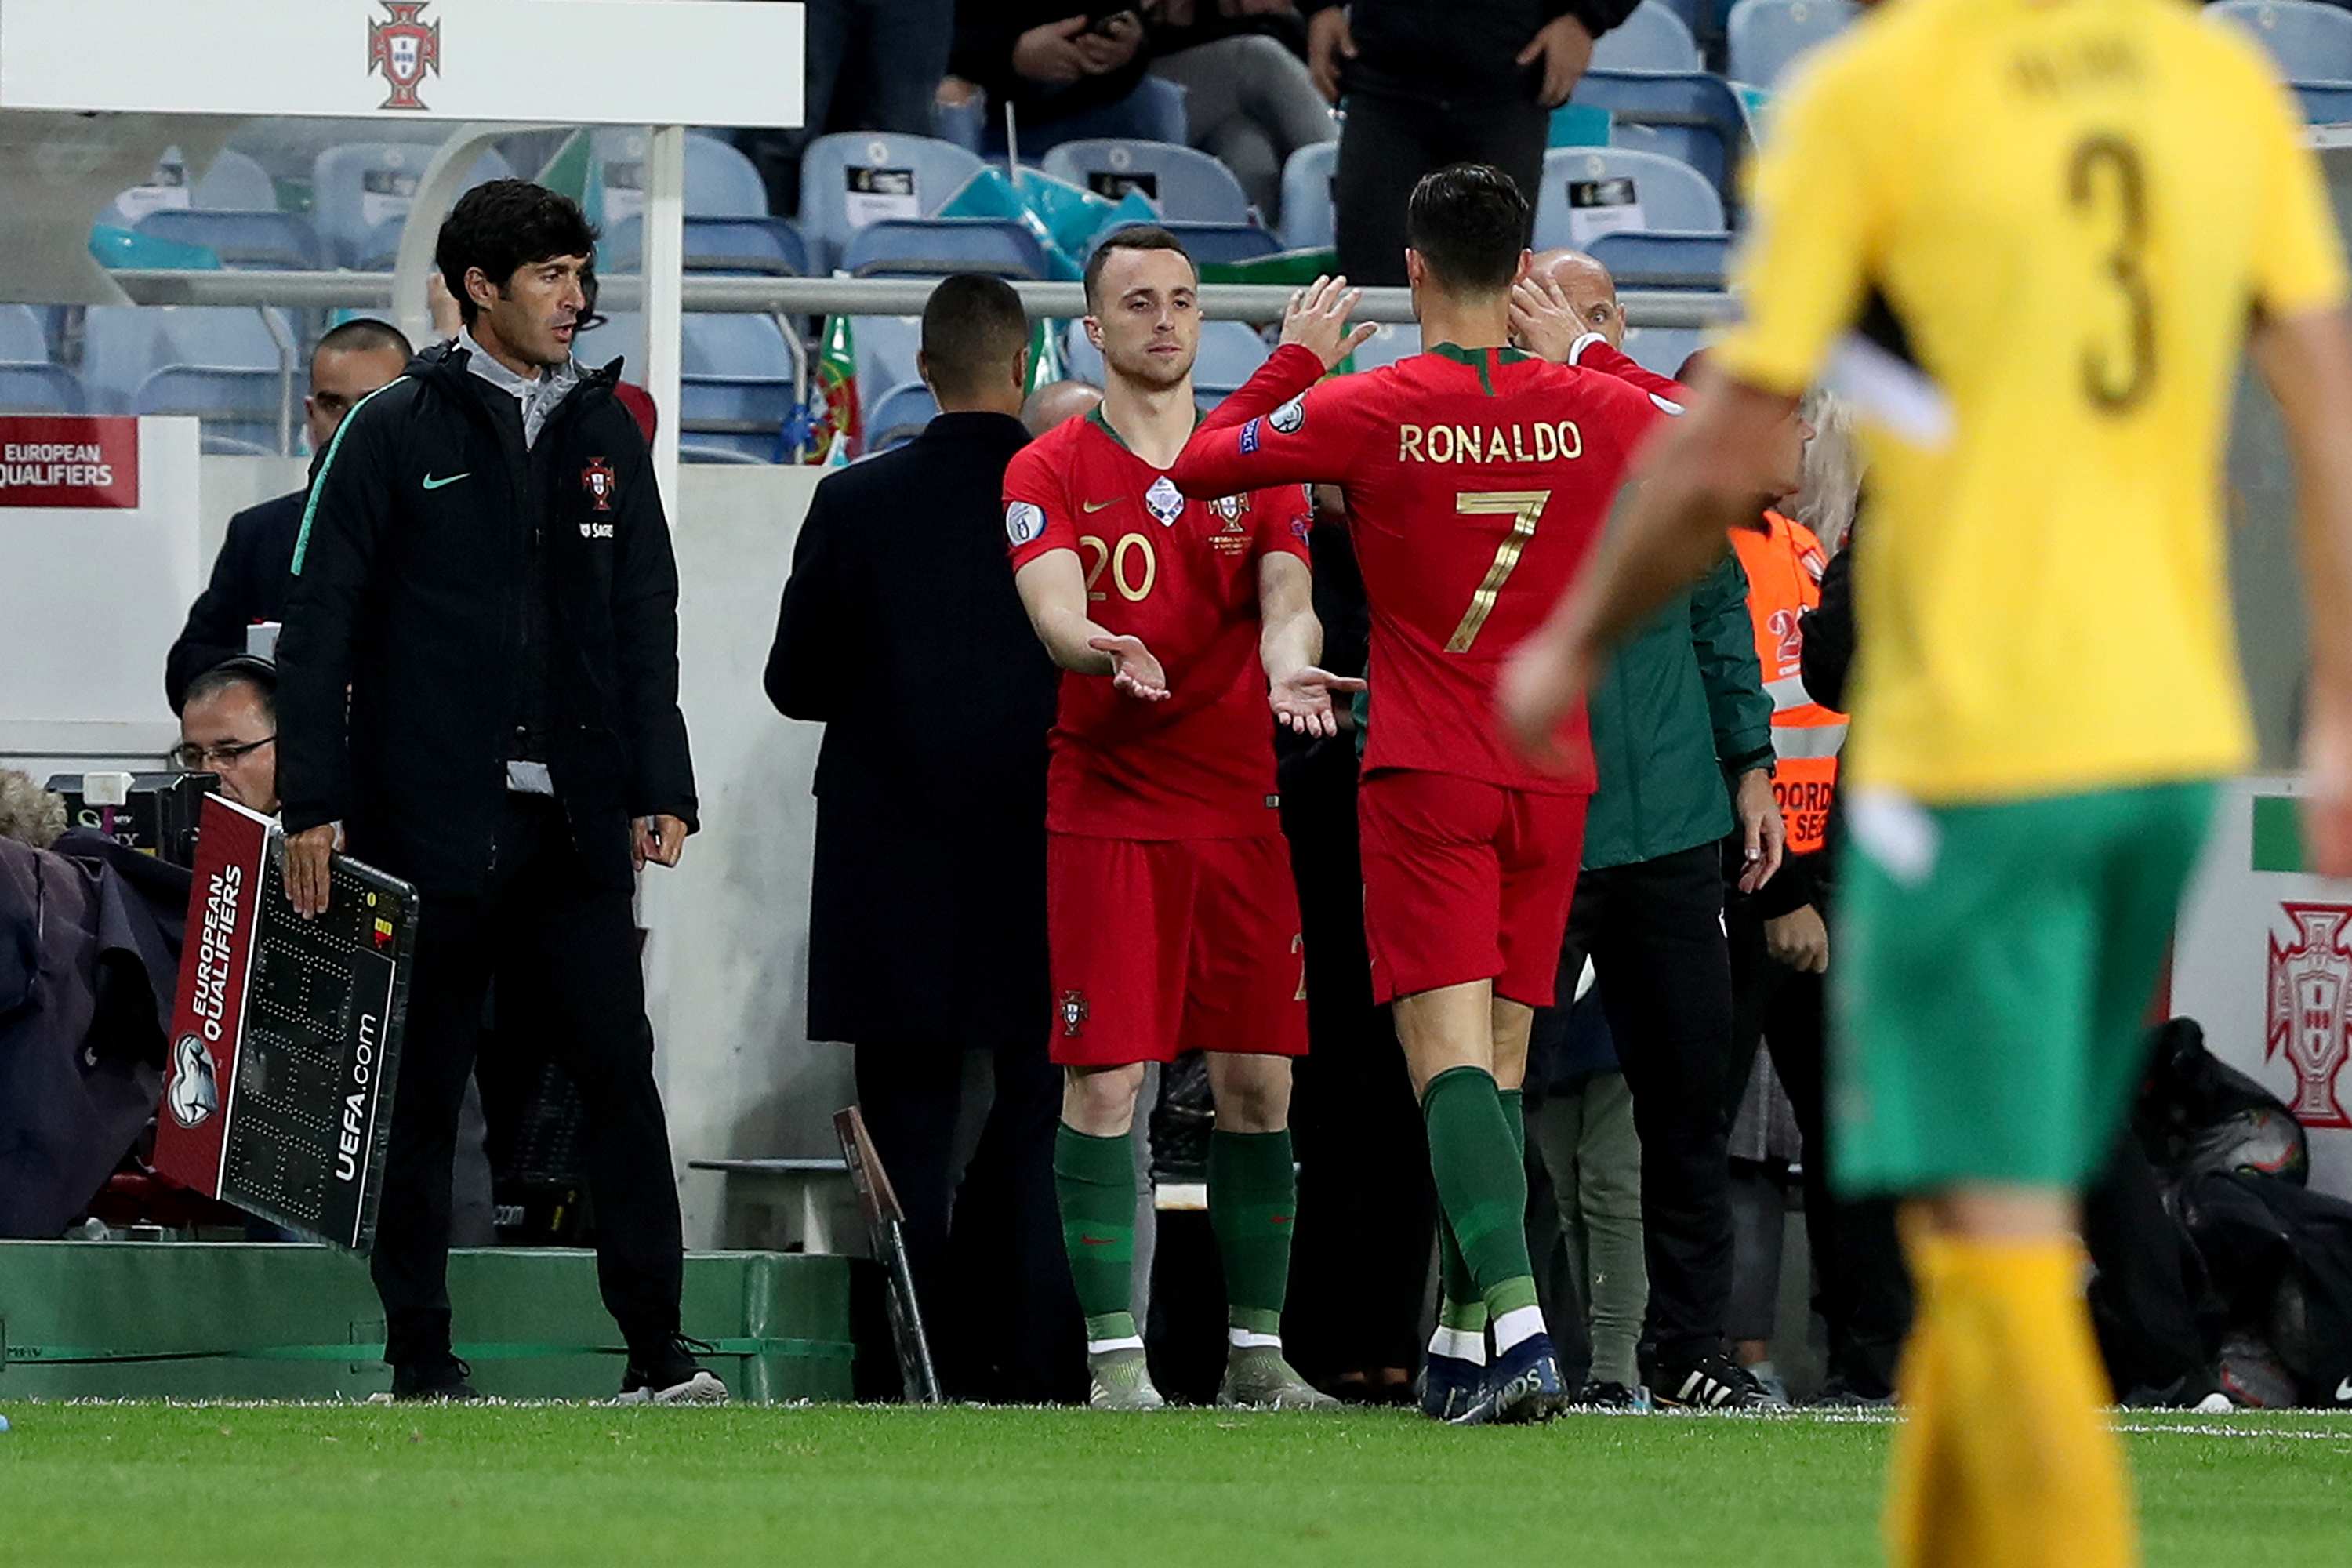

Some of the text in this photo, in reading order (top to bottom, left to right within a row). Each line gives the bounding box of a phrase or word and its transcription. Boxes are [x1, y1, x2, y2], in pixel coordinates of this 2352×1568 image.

[2067, 135, 2158, 420] 3
[5, 444, 101, 463] EUROPEAN
[1399, 421, 1582, 463] RONALDO
[1079, 533, 1156, 601] 20
[1443, 490, 1552, 653] 7
[193, 873, 224, 1017] EUROPEAN
[204, 864, 241, 1042] QUALIFIERS
[336, 1013, 377, 1181] UEFA.com
